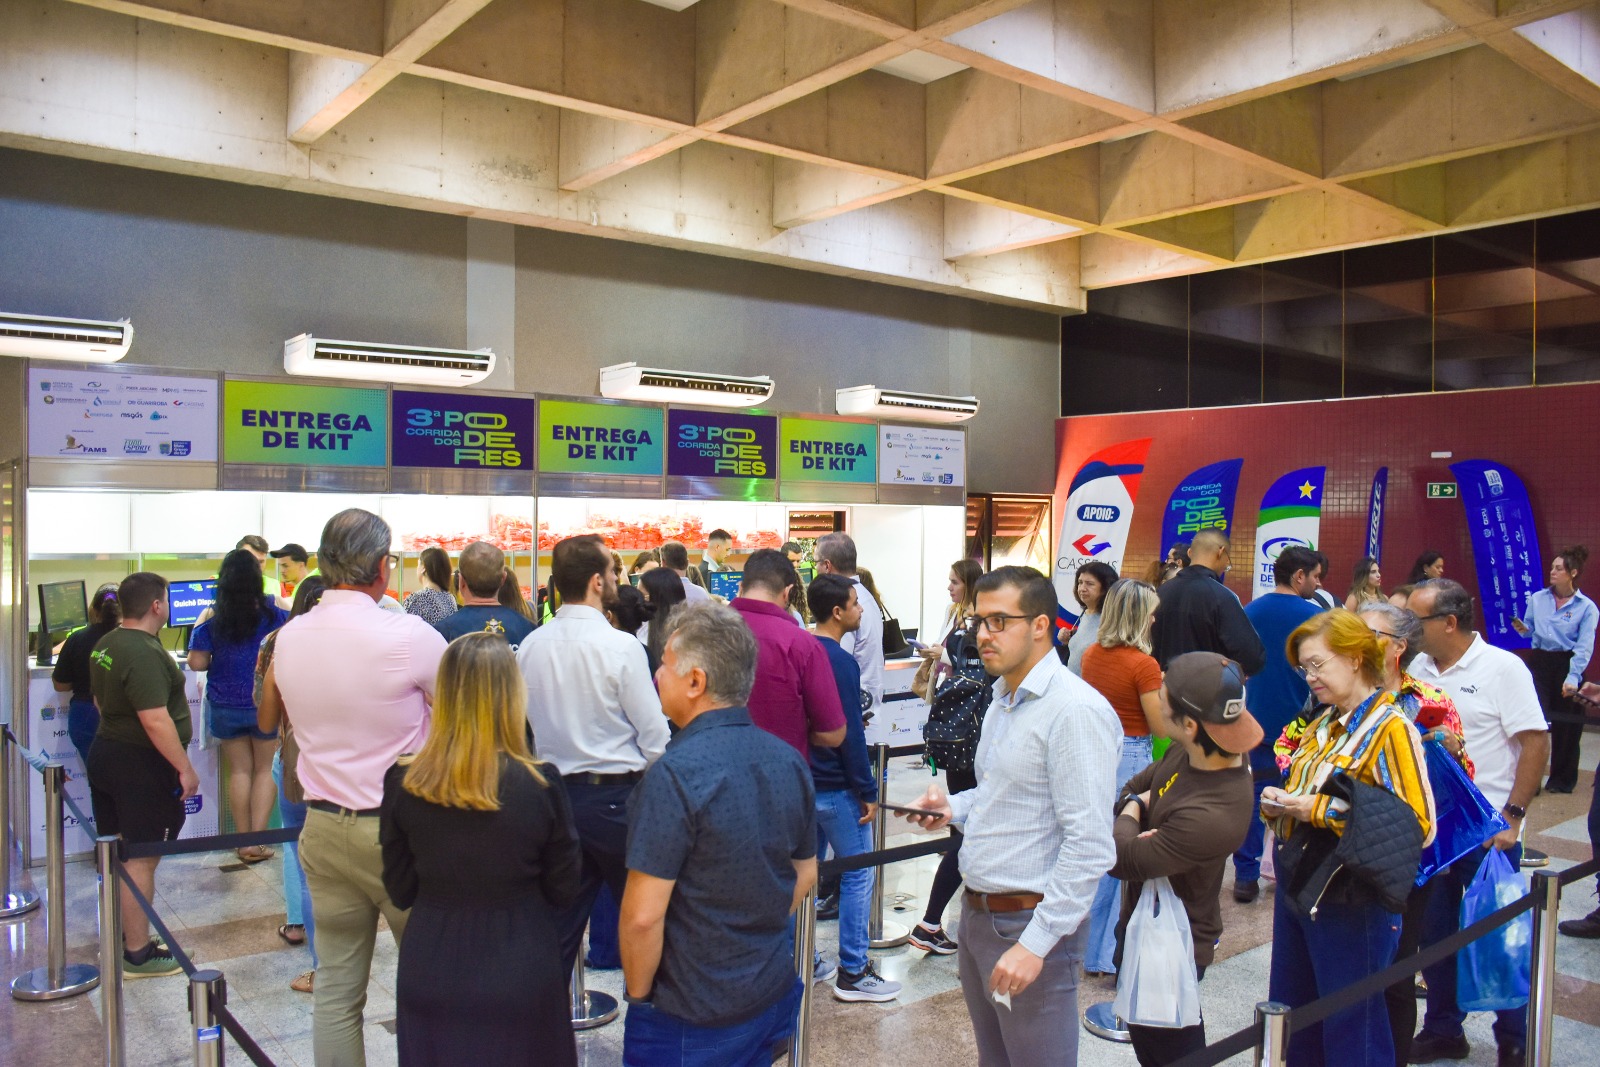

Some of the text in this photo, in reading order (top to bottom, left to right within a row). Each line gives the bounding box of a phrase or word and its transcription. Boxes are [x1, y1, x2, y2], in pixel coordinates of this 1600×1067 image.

[242, 409, 372, 432] ENTREGA
[407, 408, 441, 426] 3ª
[262, 431, 354, 450] DE KIT
[406, 428, 461, 438] CORRIDA
[434, 431, 516, 448] DOS DE
[552, 424, 652, 445] ENTREGA
[678, 424, 705, 441] 3ª
[568, 444, 638, 461] DE KIT
[677, 441, 721, 450] CORRIDA
[722, 444, 762, 460] DE
[790, 439, 868, 457] ENTREGA
[454, 448, 521, 467] RES
[802, 456, 856, 471] DE KIT
[714, 460, 767, 476] RES
[1181, 482, 1222, 492] CORRIDA
[1083, 506, 1115, 520] APOIO:
[1185, 507, 1225, 522] DE
[1057, 556, 1118, 570] CASS
[1260, 574, 1273, 583] DE
[197, 598, 216, 607] Dispo
